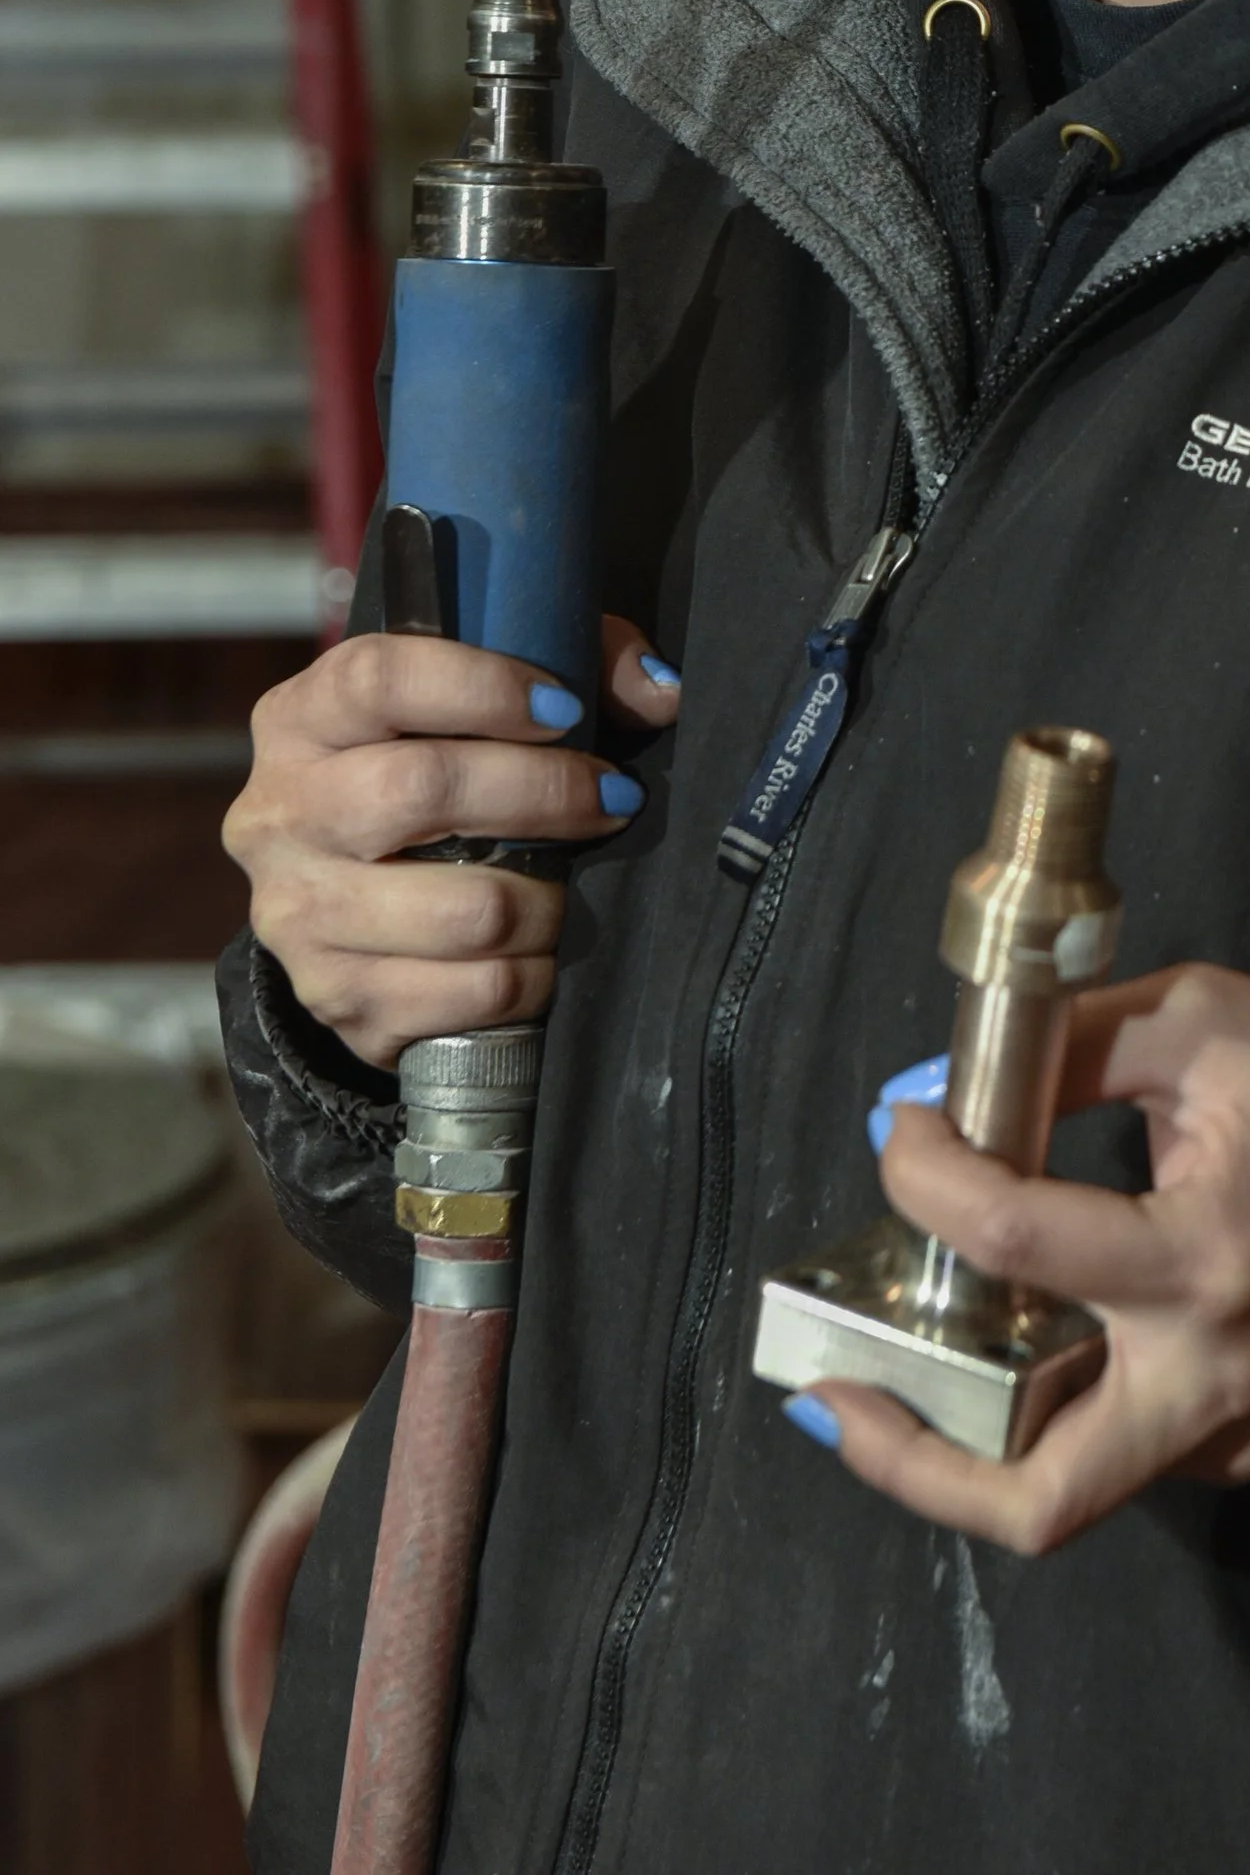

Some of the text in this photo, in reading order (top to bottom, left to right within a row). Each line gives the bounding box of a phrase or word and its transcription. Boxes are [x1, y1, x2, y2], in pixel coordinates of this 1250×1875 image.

[1176, 440, 1243, 486] Bath
[749, 672, 840, 824] Charles River
